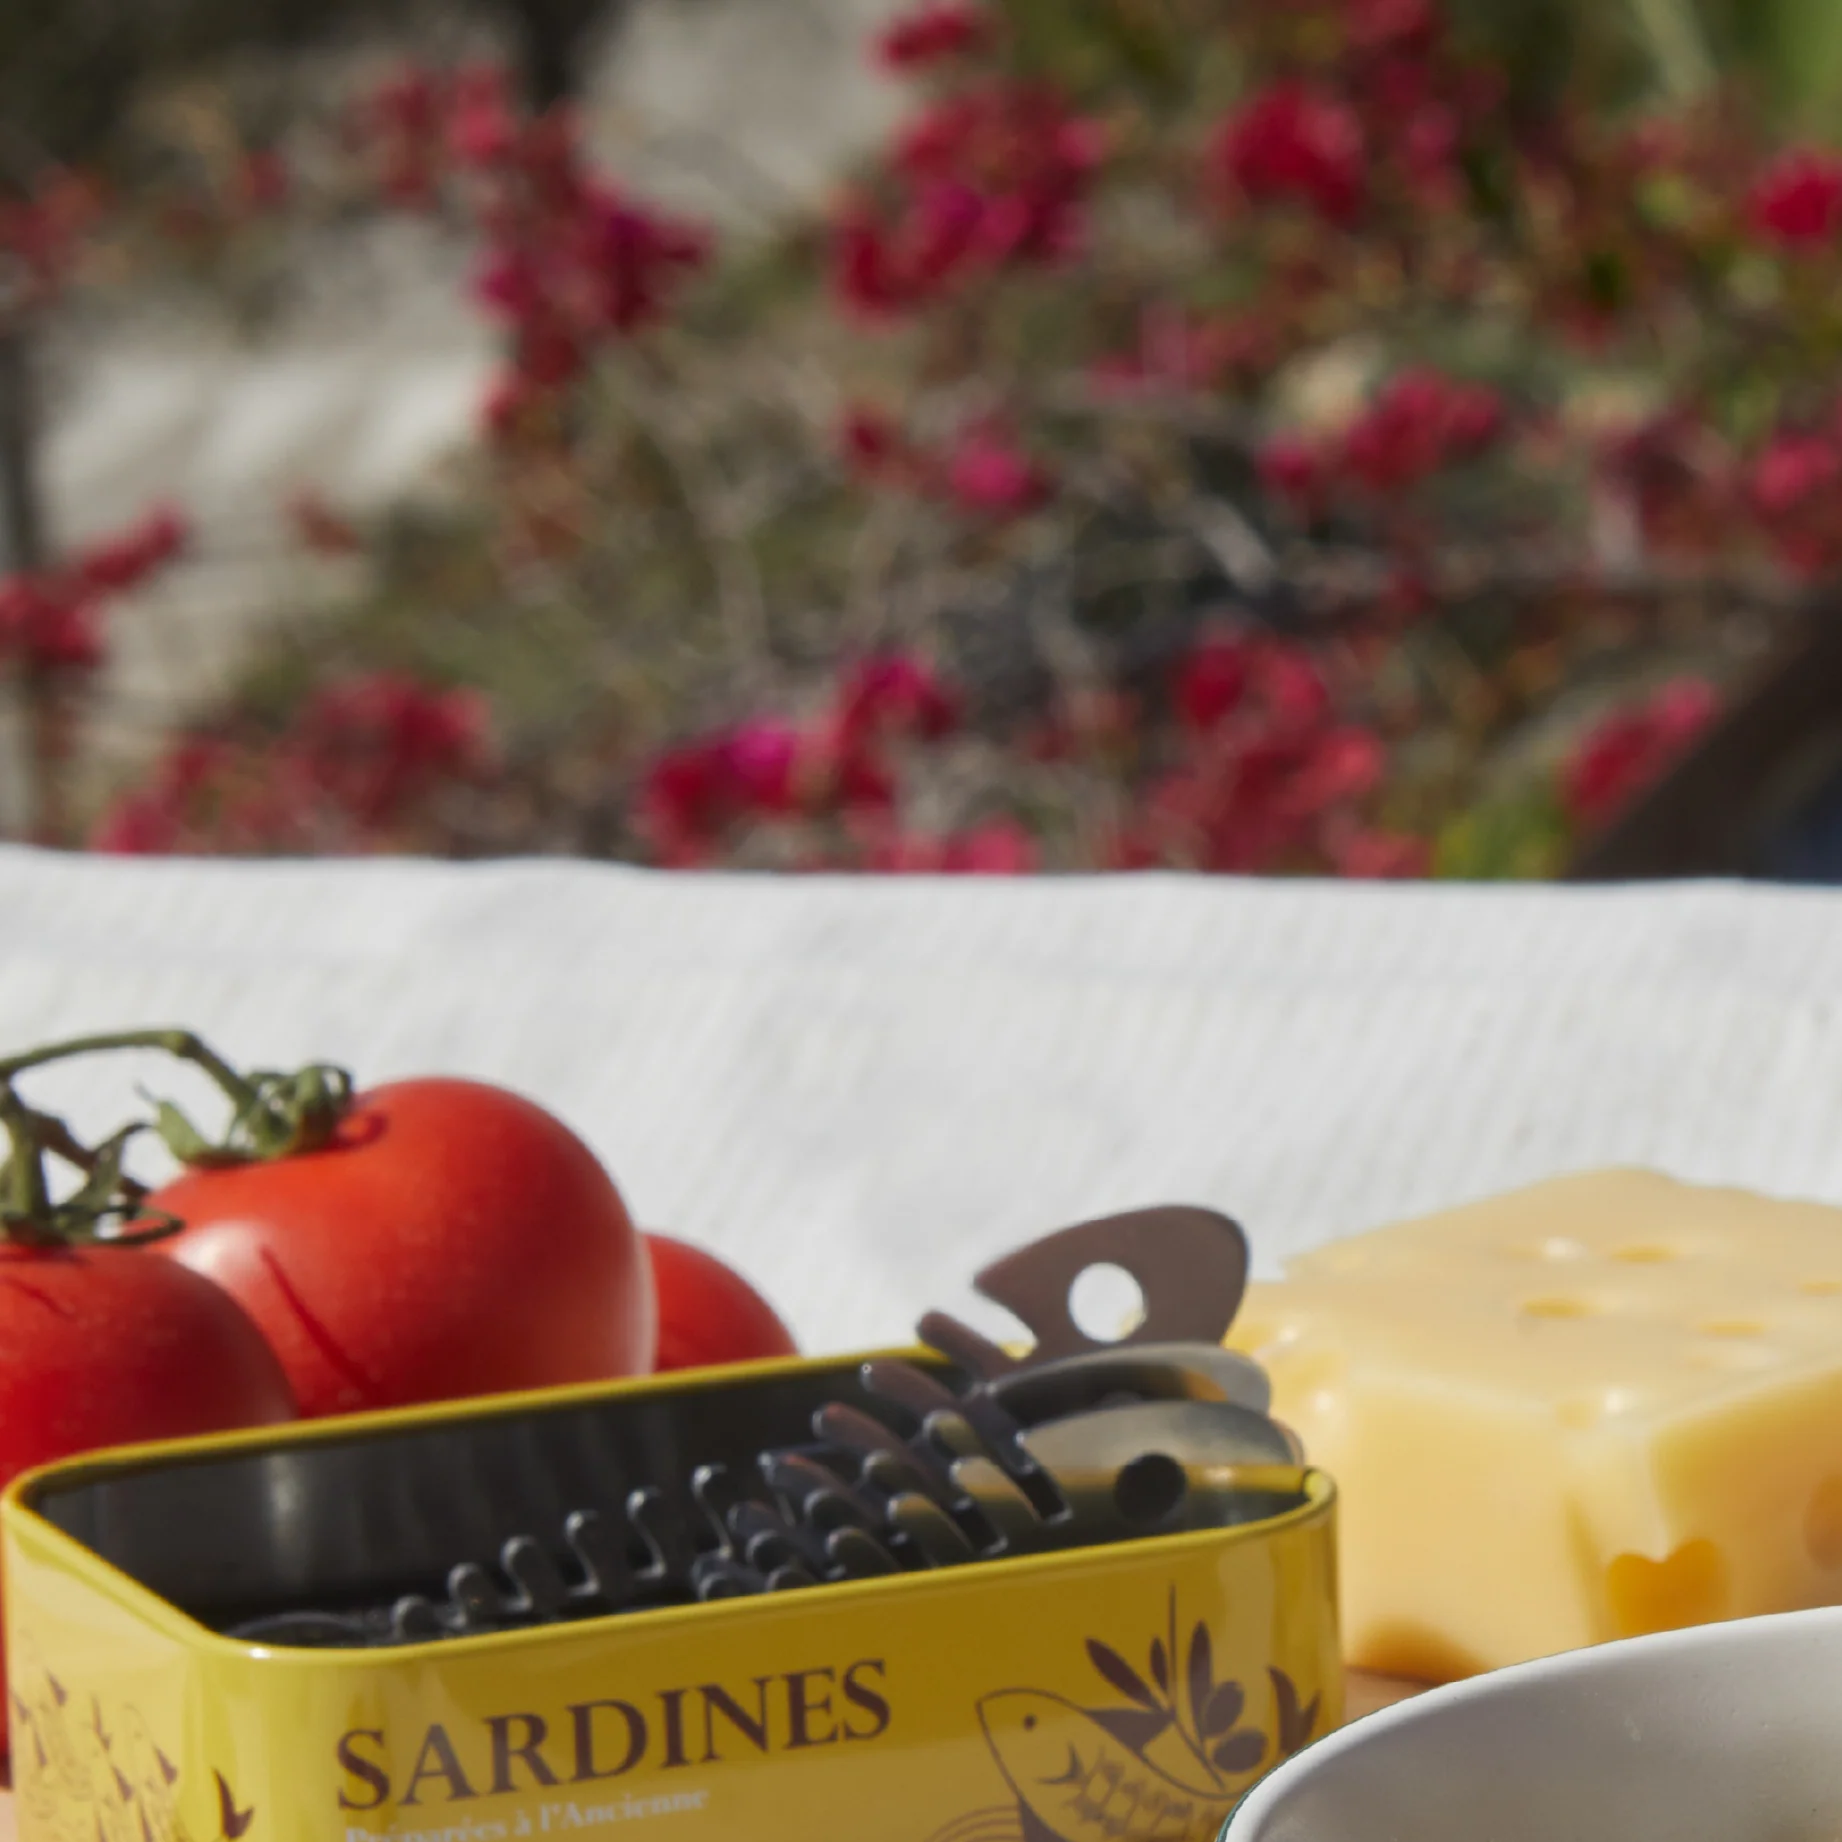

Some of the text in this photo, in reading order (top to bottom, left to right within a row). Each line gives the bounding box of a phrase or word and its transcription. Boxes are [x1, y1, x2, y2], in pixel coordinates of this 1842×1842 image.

[336, 1658, 892, 1812] SARDINES
[513, 1809, 532, 1837] à
[539, 1788, 709, 1833] l'Ancienne
